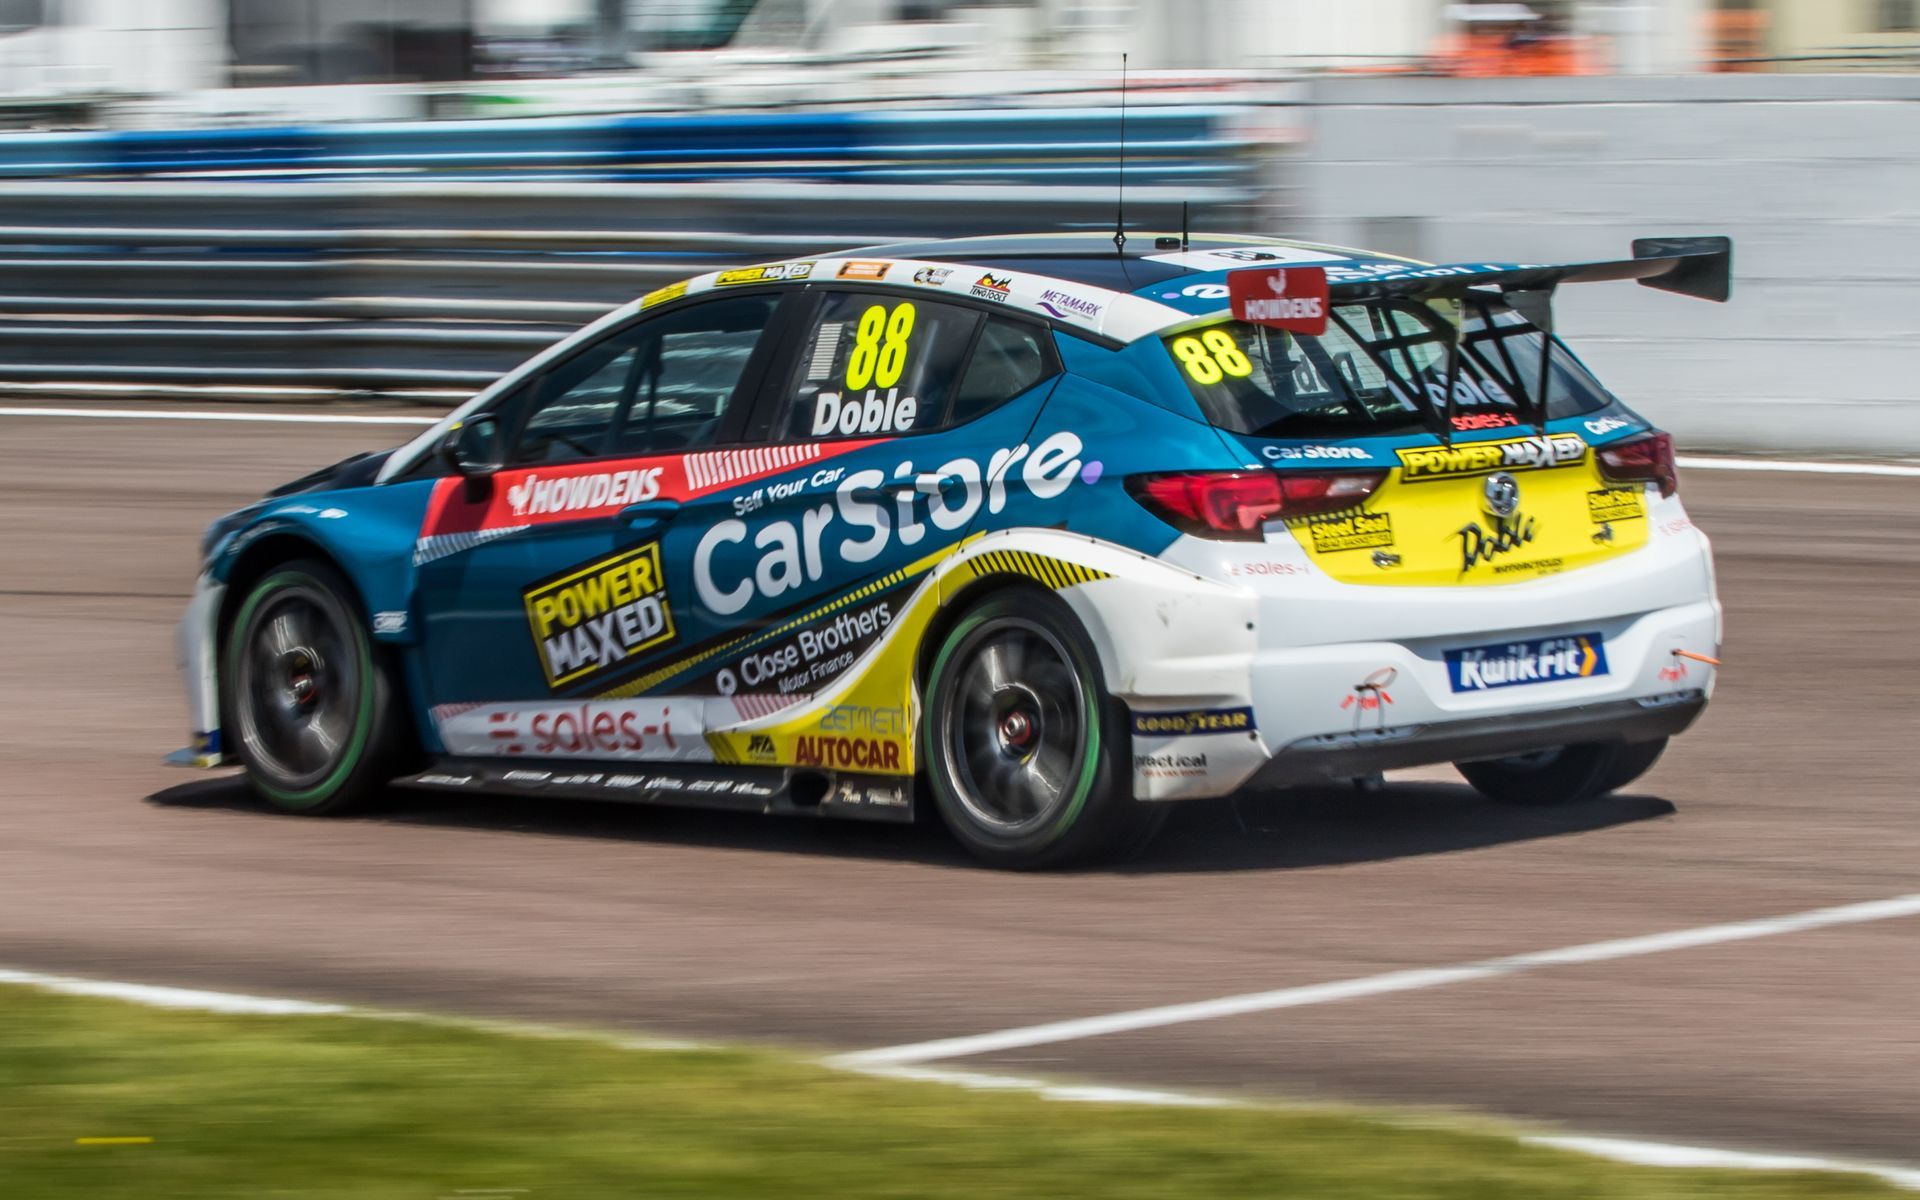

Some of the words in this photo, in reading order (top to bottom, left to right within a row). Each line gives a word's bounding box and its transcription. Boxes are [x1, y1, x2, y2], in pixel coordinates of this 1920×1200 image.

[722, 268, 765, 283] POWER
[762, 262, 811, 281] MAXED
[1040, 289, 1103, 316] METAMARK
[846, 302, 916, 391] 88
[1172, 329, 1253, 385] 88
[811, 387, 917, 437] Doble
[1407, 446, 1503, 475] POWER
[1500, 436, 1585, 468] MAXED
[528, 466, 664, 514] HOWDENS
[733, 494, 764, 517] Sell
[766, 479, 806, 504] Your
[1311, 518, 1356, 541] Steel
[535, 556, 657, 638] POWER
[543, 596, 665, 678] MAXED
[740, 644, 799, 686] Close
[798, 601, 892, 661] Brothers
[777, 669, 810, 694] Motor
[809, 651, 854, 681] Finance
[531, 703, 678, 753] sales-i
[796, 735, 900, 770] AUTOCAR
